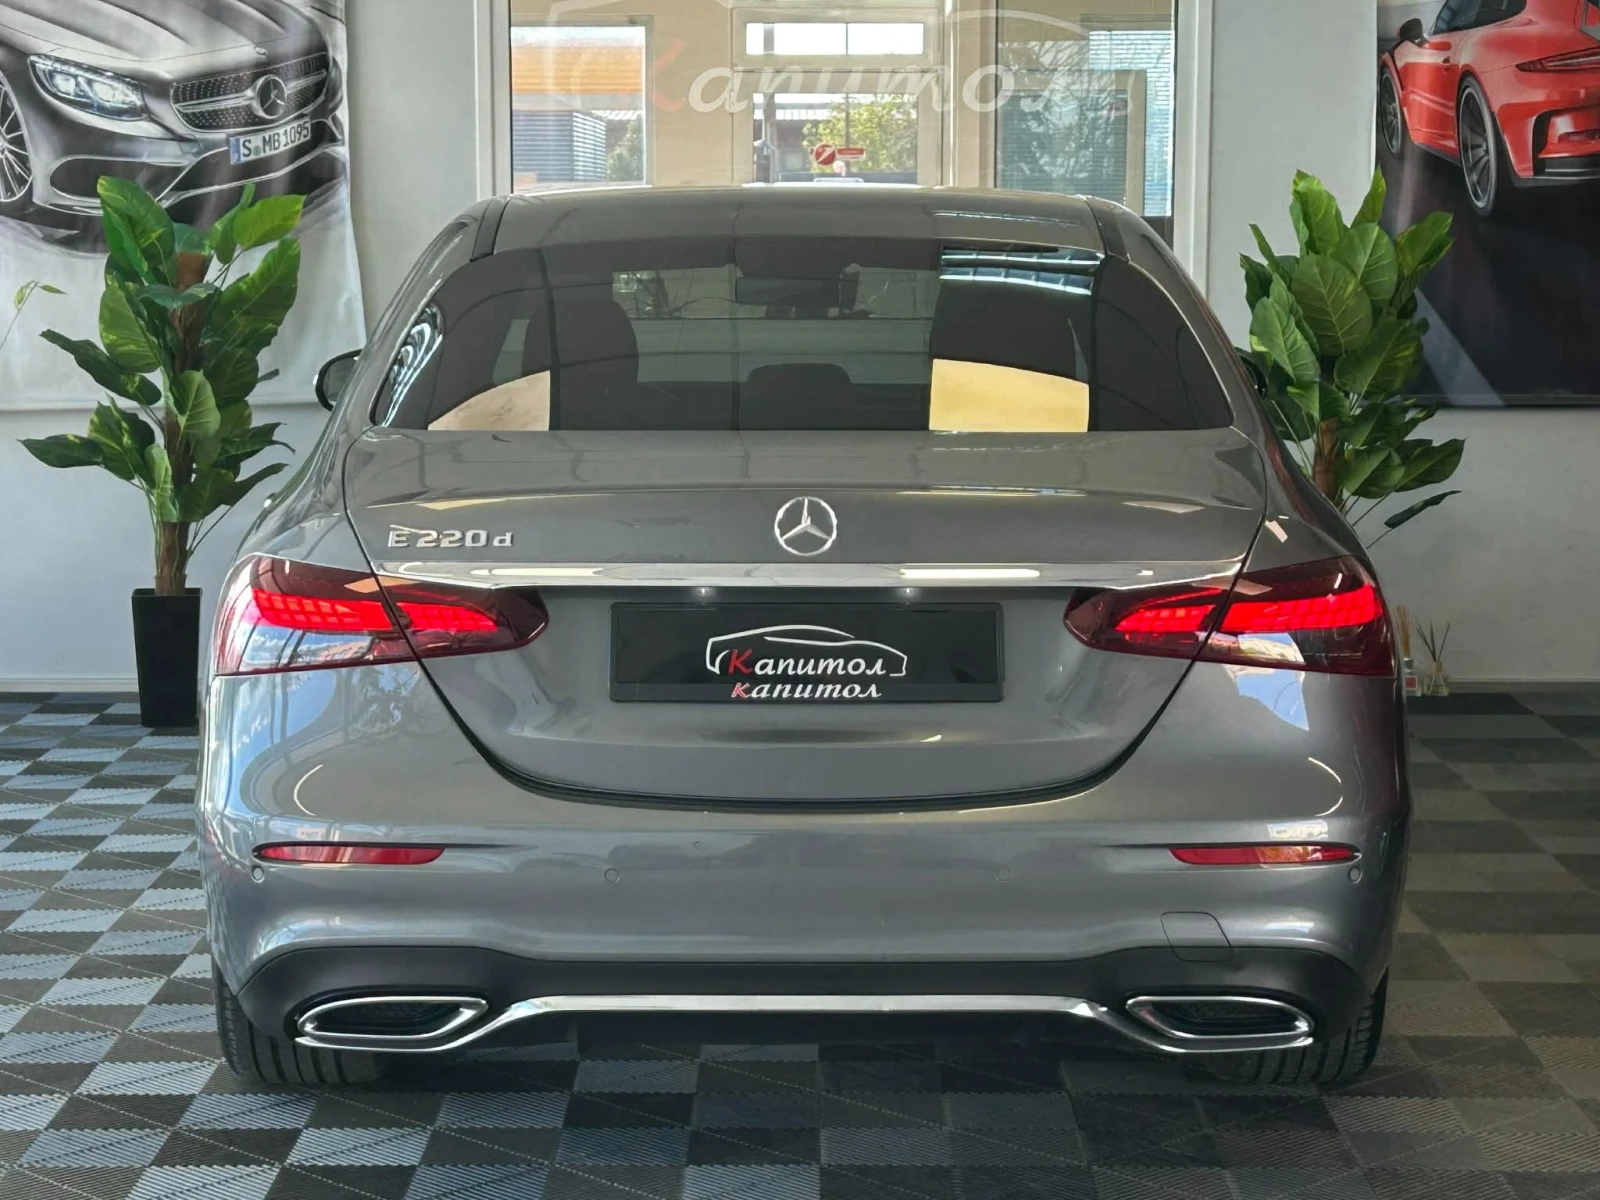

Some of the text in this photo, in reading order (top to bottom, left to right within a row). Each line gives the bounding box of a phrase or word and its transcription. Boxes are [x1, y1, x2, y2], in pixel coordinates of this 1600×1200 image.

[242, 120, 310, 157] S MB 1095
[416, 529, 488, 547] 220
[728, 649, 887, 676] Капитол
